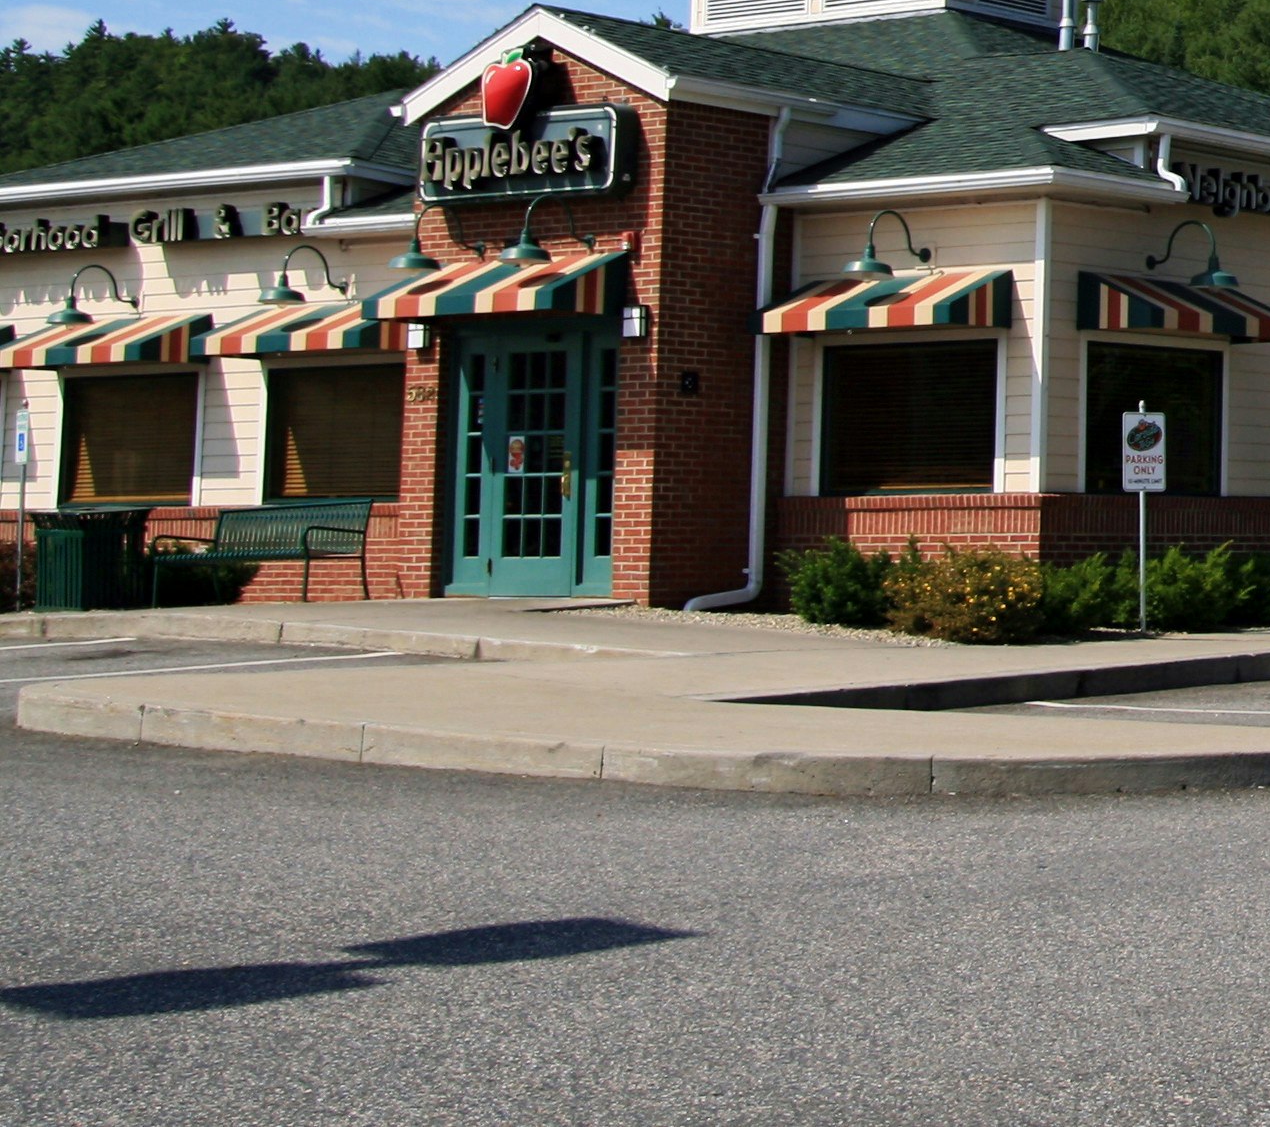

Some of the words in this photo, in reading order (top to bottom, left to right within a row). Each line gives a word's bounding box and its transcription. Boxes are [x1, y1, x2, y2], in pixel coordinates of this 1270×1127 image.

[421, 127, 595, 191] Applebee's
[129, 209, 190, 244] Grill
[213, 204, 238, 239] &
[1125, 455, 1164, 464] PARKING
[1133, 466, 1156, 475] ONLY
